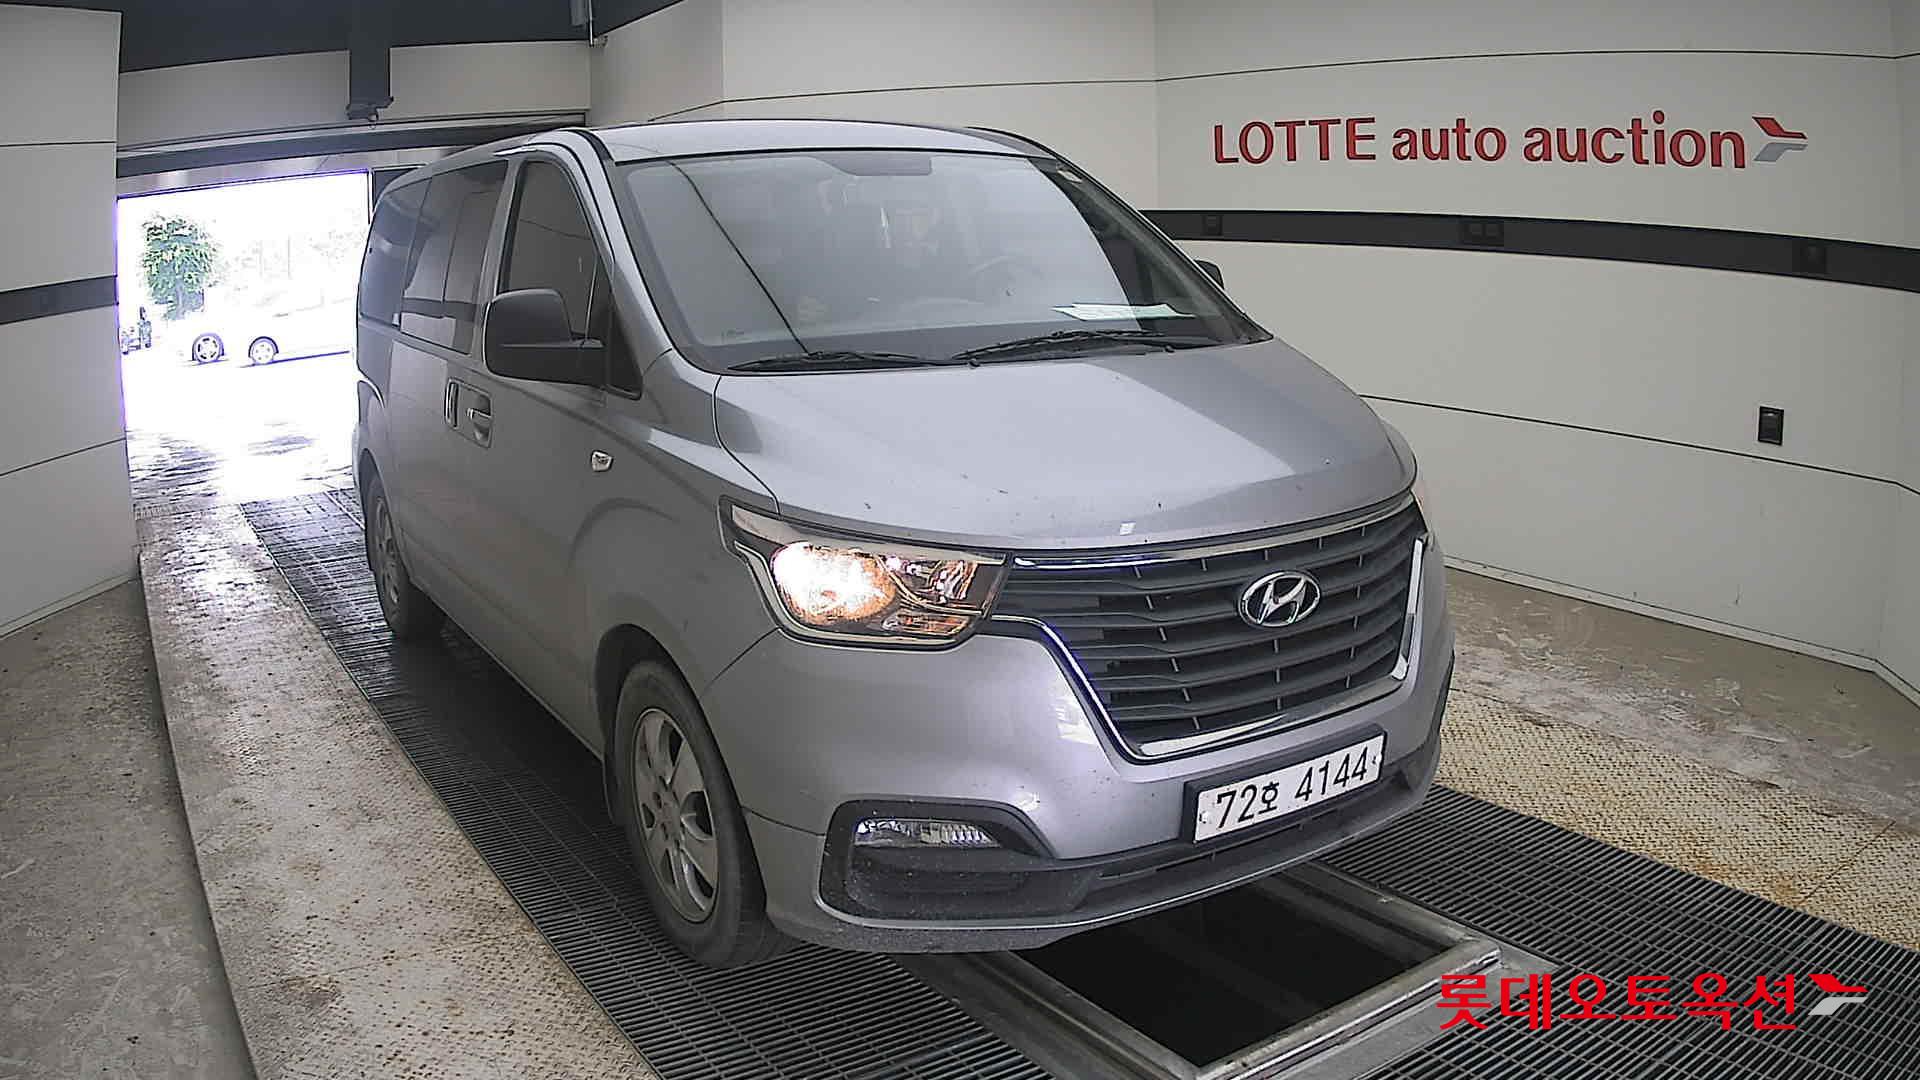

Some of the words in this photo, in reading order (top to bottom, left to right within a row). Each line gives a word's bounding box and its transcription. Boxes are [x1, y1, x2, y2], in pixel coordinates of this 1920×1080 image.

[1213, 117, 1376, 164] LOTTE
[1391, 117, 1506, 162] auto
[1522, 110, 1746, 169] auction
[1216, 781, 1280, 828] 72호
[1295, 747, 1368, 801] 4144
